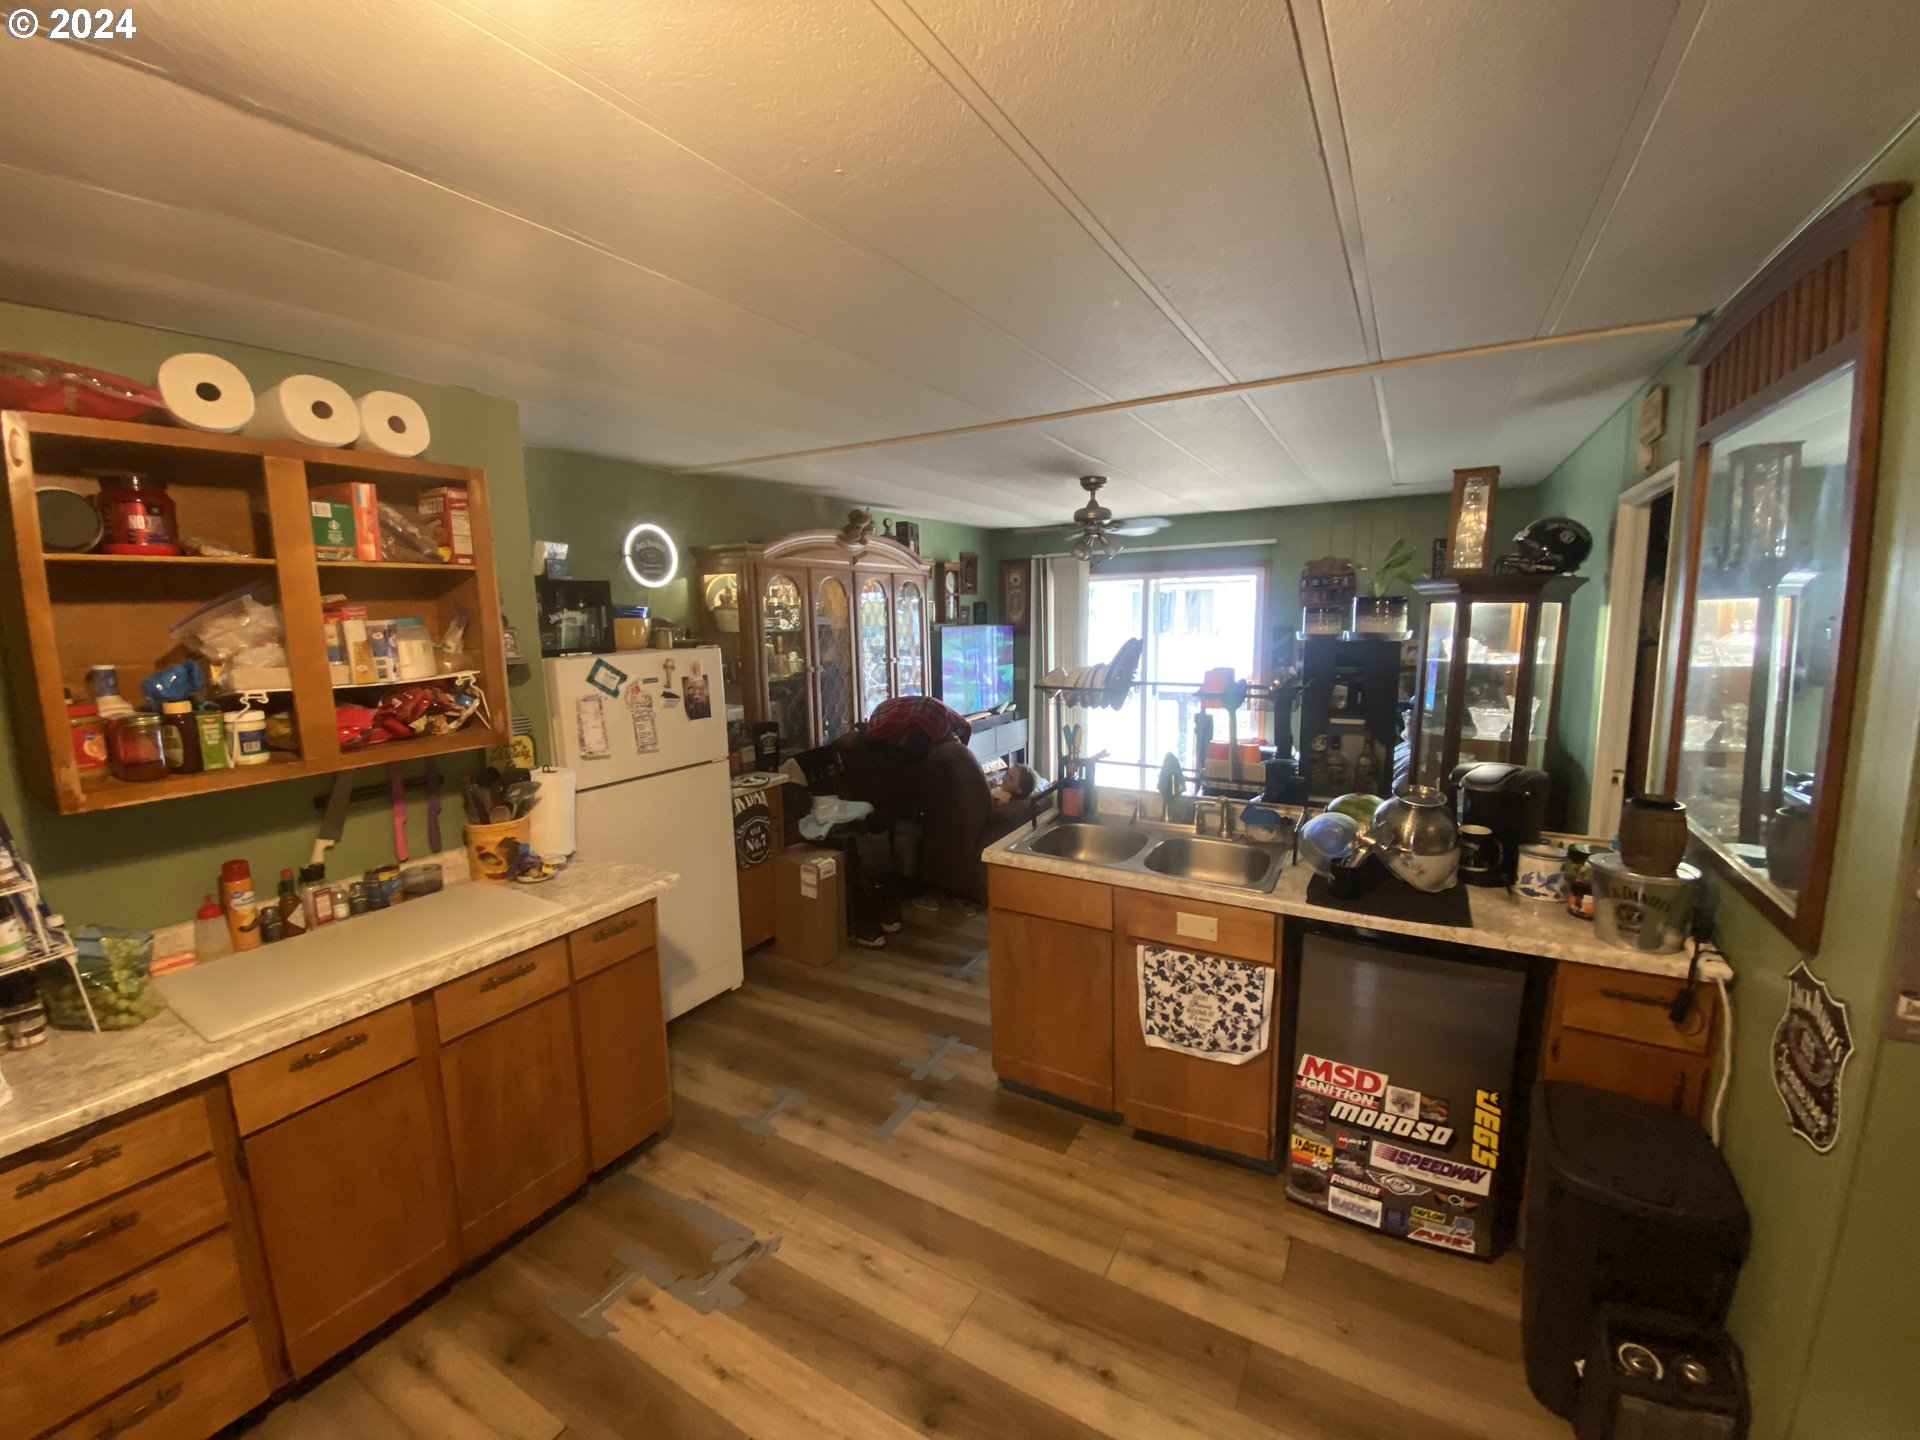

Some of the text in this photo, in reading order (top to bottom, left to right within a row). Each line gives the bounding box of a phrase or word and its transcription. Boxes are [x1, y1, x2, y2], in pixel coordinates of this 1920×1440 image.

[1302, 1055, 1382, 1094] MSD
[1300, 1077, 1375, 1106] IGNITION
[1329, 1101, 1454, 1146] MOROSO
[1338, 1136, 1369, 1147] HURST
[1395, 1149, 1488, 1185] SPEEDWAY
[1329, 1174, 1381, 1196] FLOWMASTER
[1413, 1207, 1446, 1221] TAYLOR
